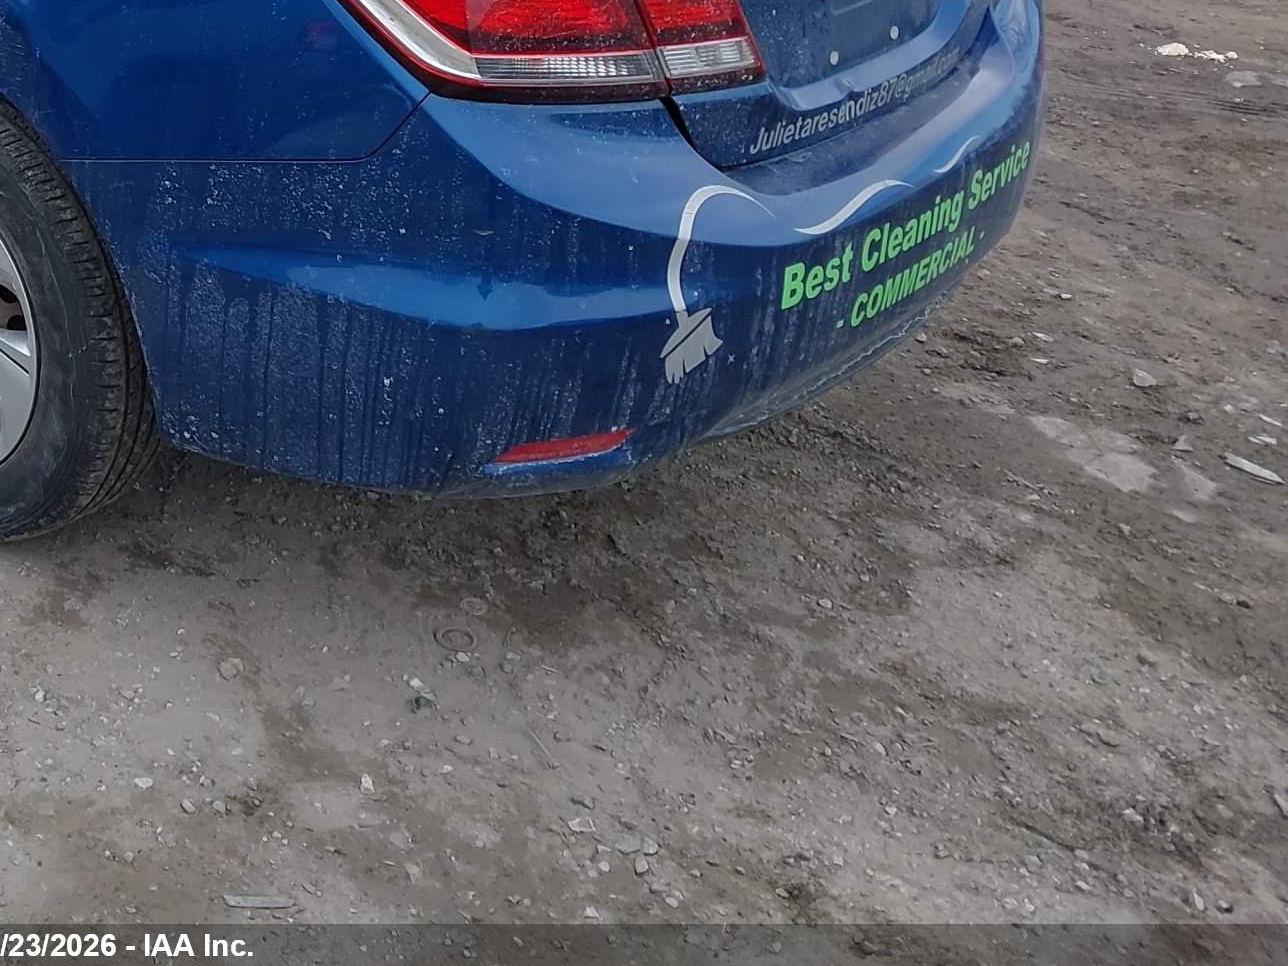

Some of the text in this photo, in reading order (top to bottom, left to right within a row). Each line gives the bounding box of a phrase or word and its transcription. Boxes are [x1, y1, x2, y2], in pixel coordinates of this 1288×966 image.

[781, 141, 1031, 311] Best Cleaning Service
[850, 225, 976, 328] COMMERCIAL
